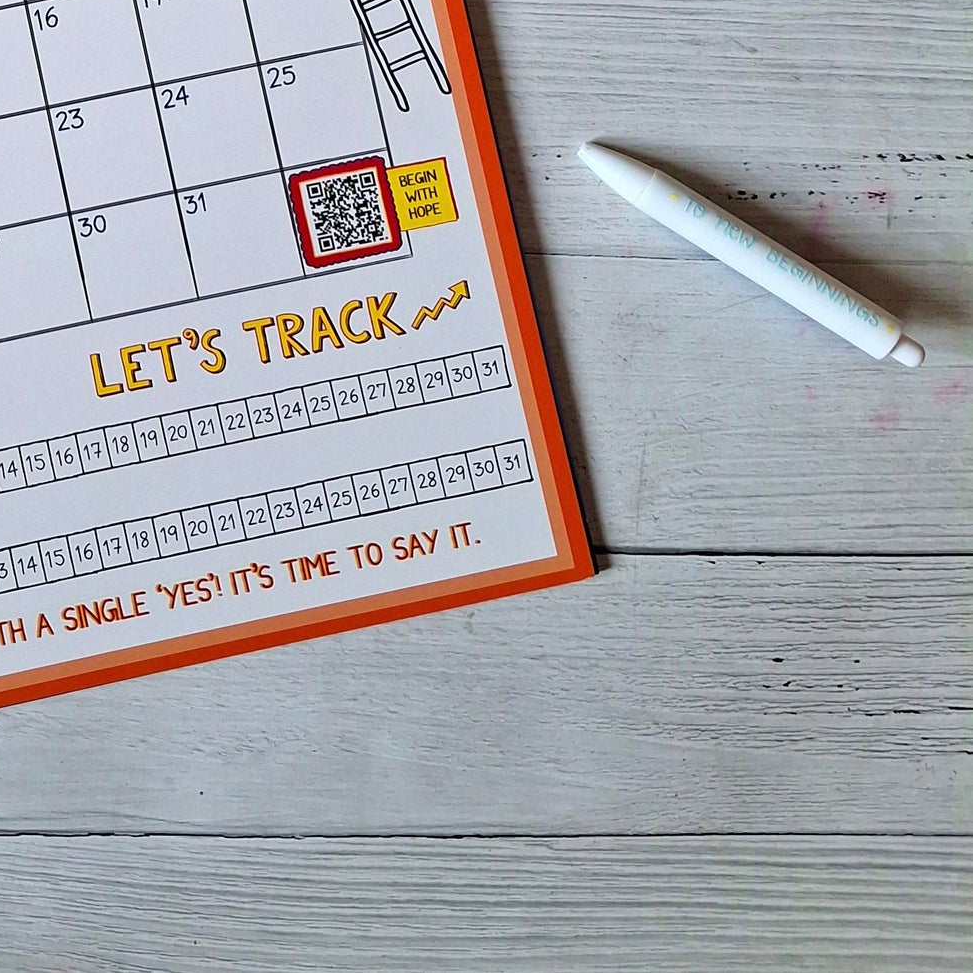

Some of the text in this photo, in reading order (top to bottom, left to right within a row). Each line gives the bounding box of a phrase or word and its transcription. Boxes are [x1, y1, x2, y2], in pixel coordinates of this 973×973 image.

[34, 5, 58, 31] 16
[266, 66, 297, 90] 25
[398, 169, 439, 188] BEGIN
[183, 192, 208, 215] 31
[405, 186, 439, 203] WITH
[407, 202, 442, 220] HOPE
[765, 249, 881, 329] BEGINNINGS
[88, 291, 406, 399] LET'S TRACK
[451, 365, 473, 383] 30
[188, 454, 521, 537] 20 31
[35, 613, 54, 639] A
[61, 591, 150, 631] SINGLE
[281, 550, 341, 584] TIME
[347, 542, 383, 569] TO
[391, 529, 439, 561] SAY
[449, 522, 481, 549] IT.
